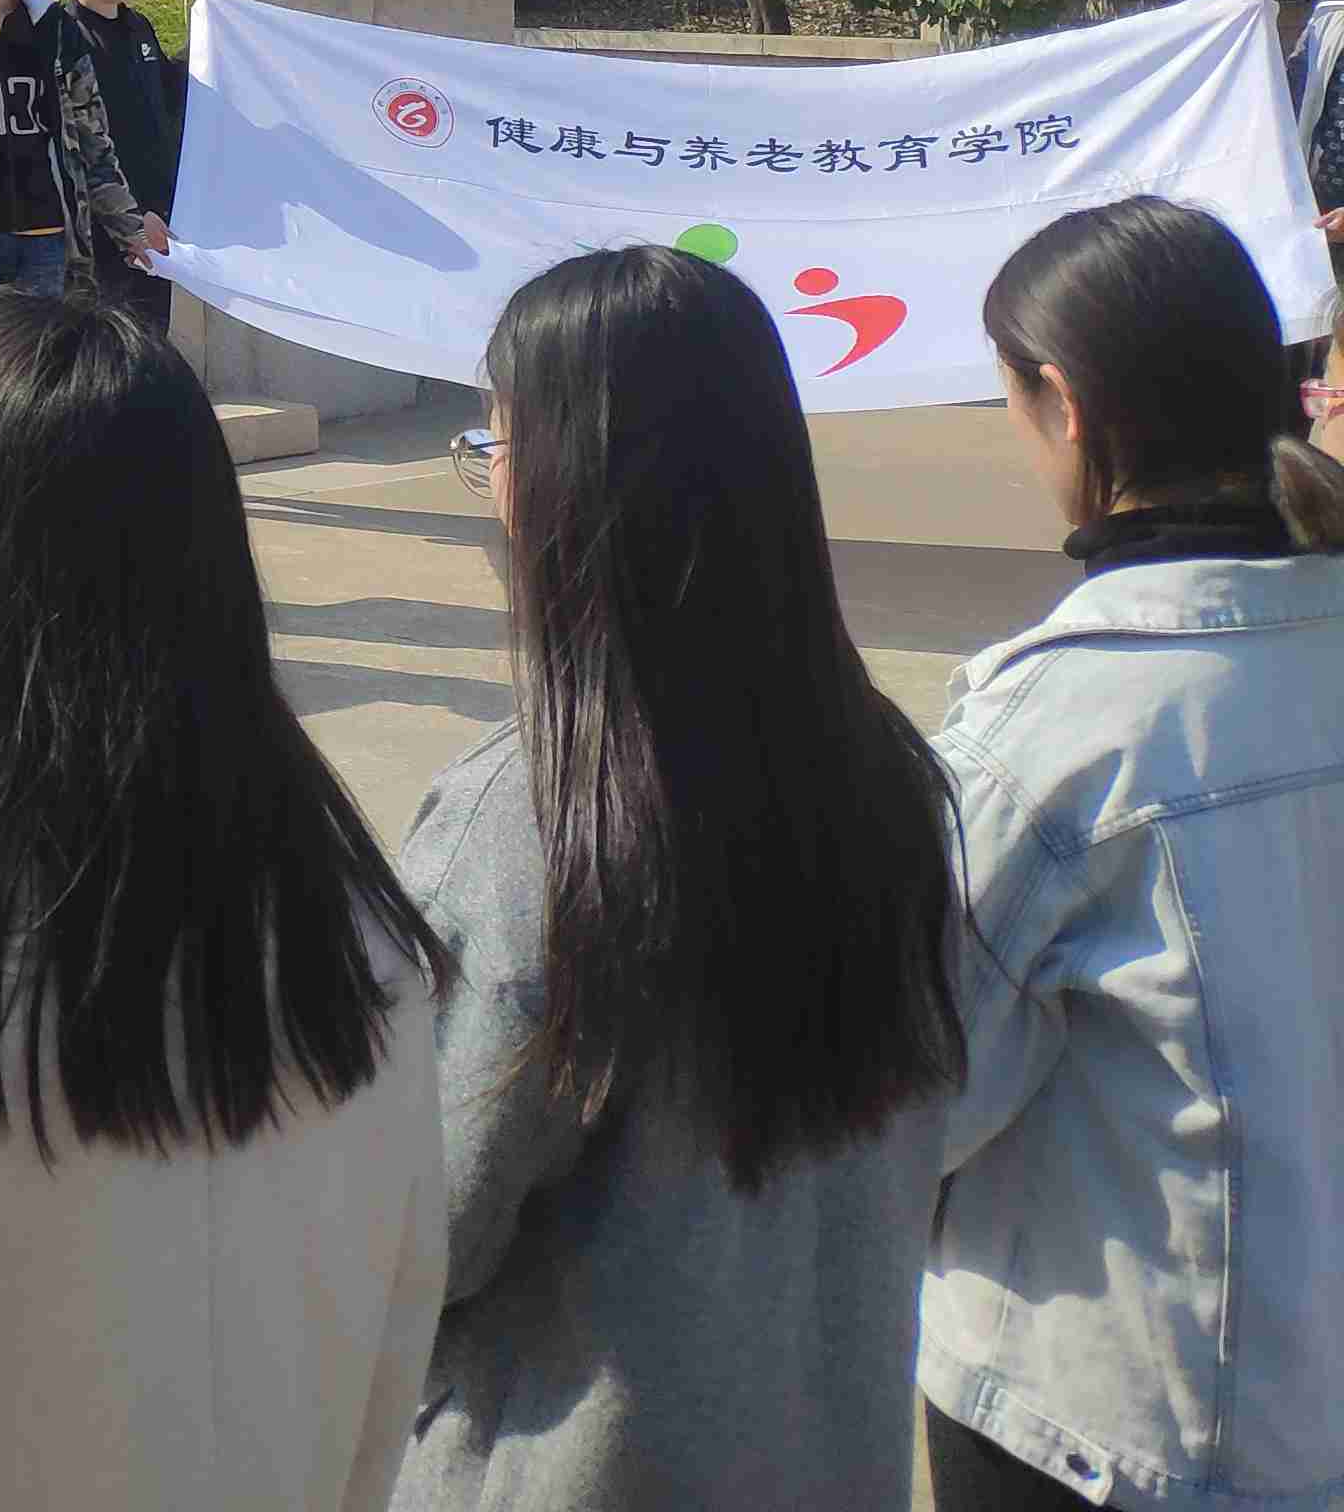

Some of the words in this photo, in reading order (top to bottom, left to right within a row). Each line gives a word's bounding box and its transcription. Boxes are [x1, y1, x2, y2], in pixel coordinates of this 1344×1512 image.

[485, 114, 1081, 173] 健康与养老教育学院
